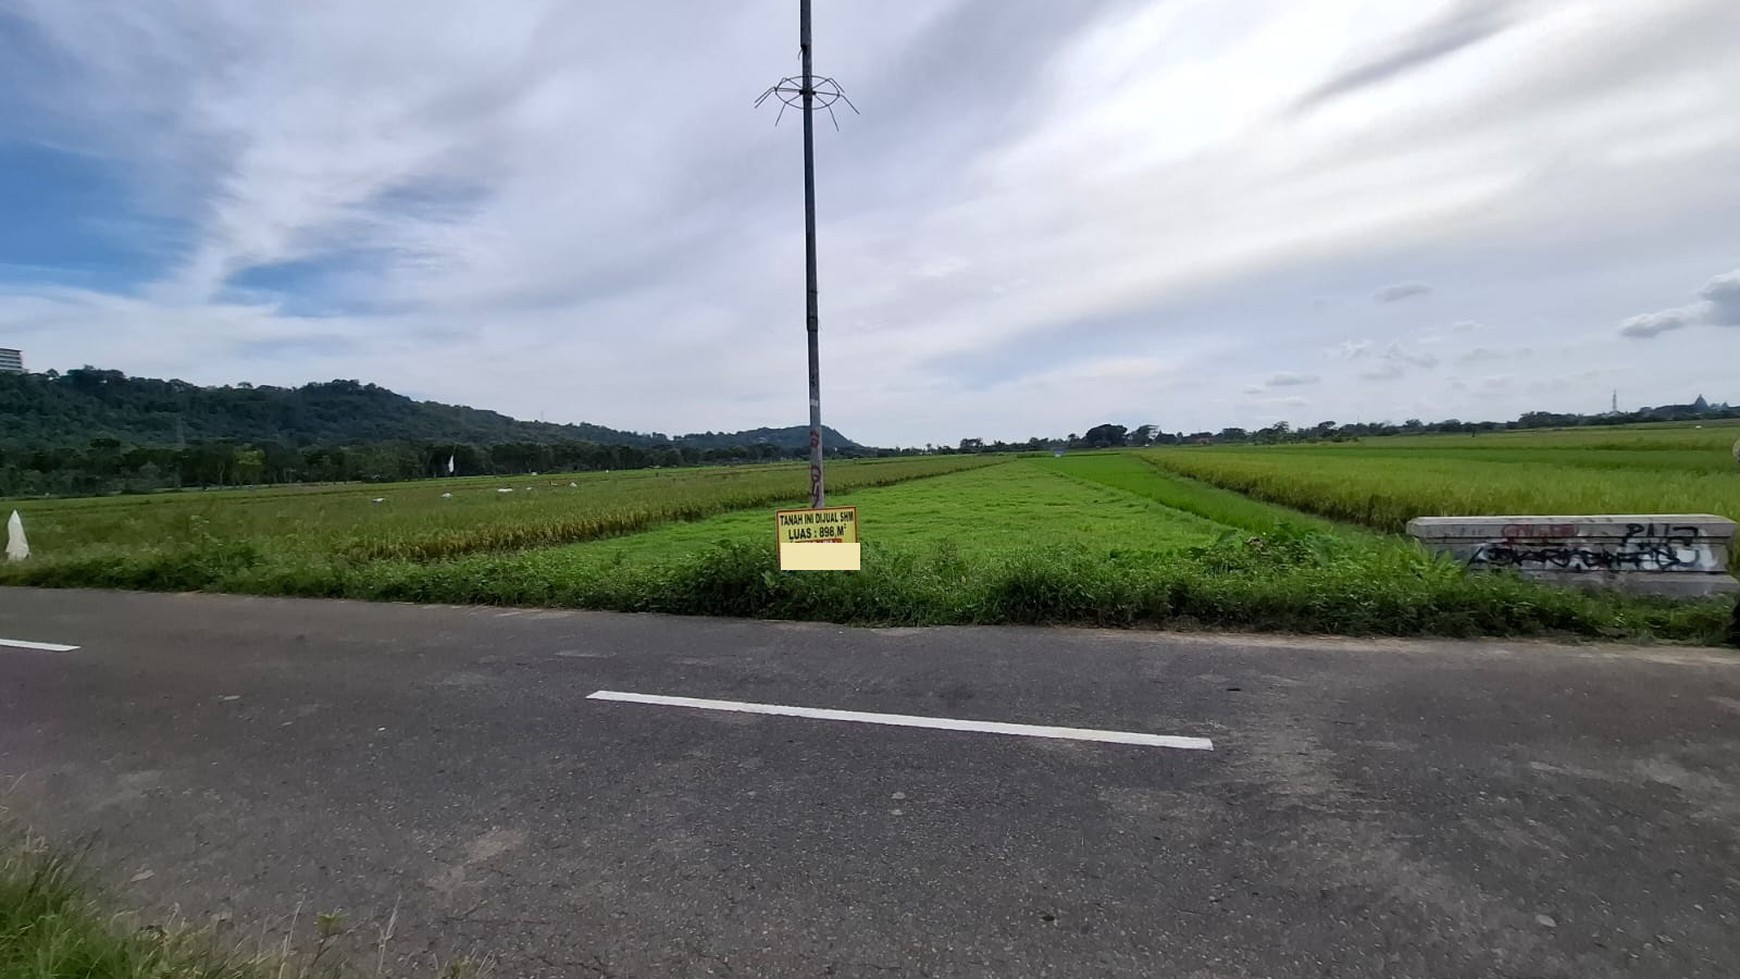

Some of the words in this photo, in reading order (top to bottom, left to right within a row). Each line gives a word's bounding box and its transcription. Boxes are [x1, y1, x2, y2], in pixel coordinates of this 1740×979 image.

[780, 513, 803, 526] TANAH
[805, 512, 814, 524] INI
[815, 511, 838, 523] DIJUAL
[840, 510, 854, 522] SHM
[788, 528, 812, 540] LUAS
